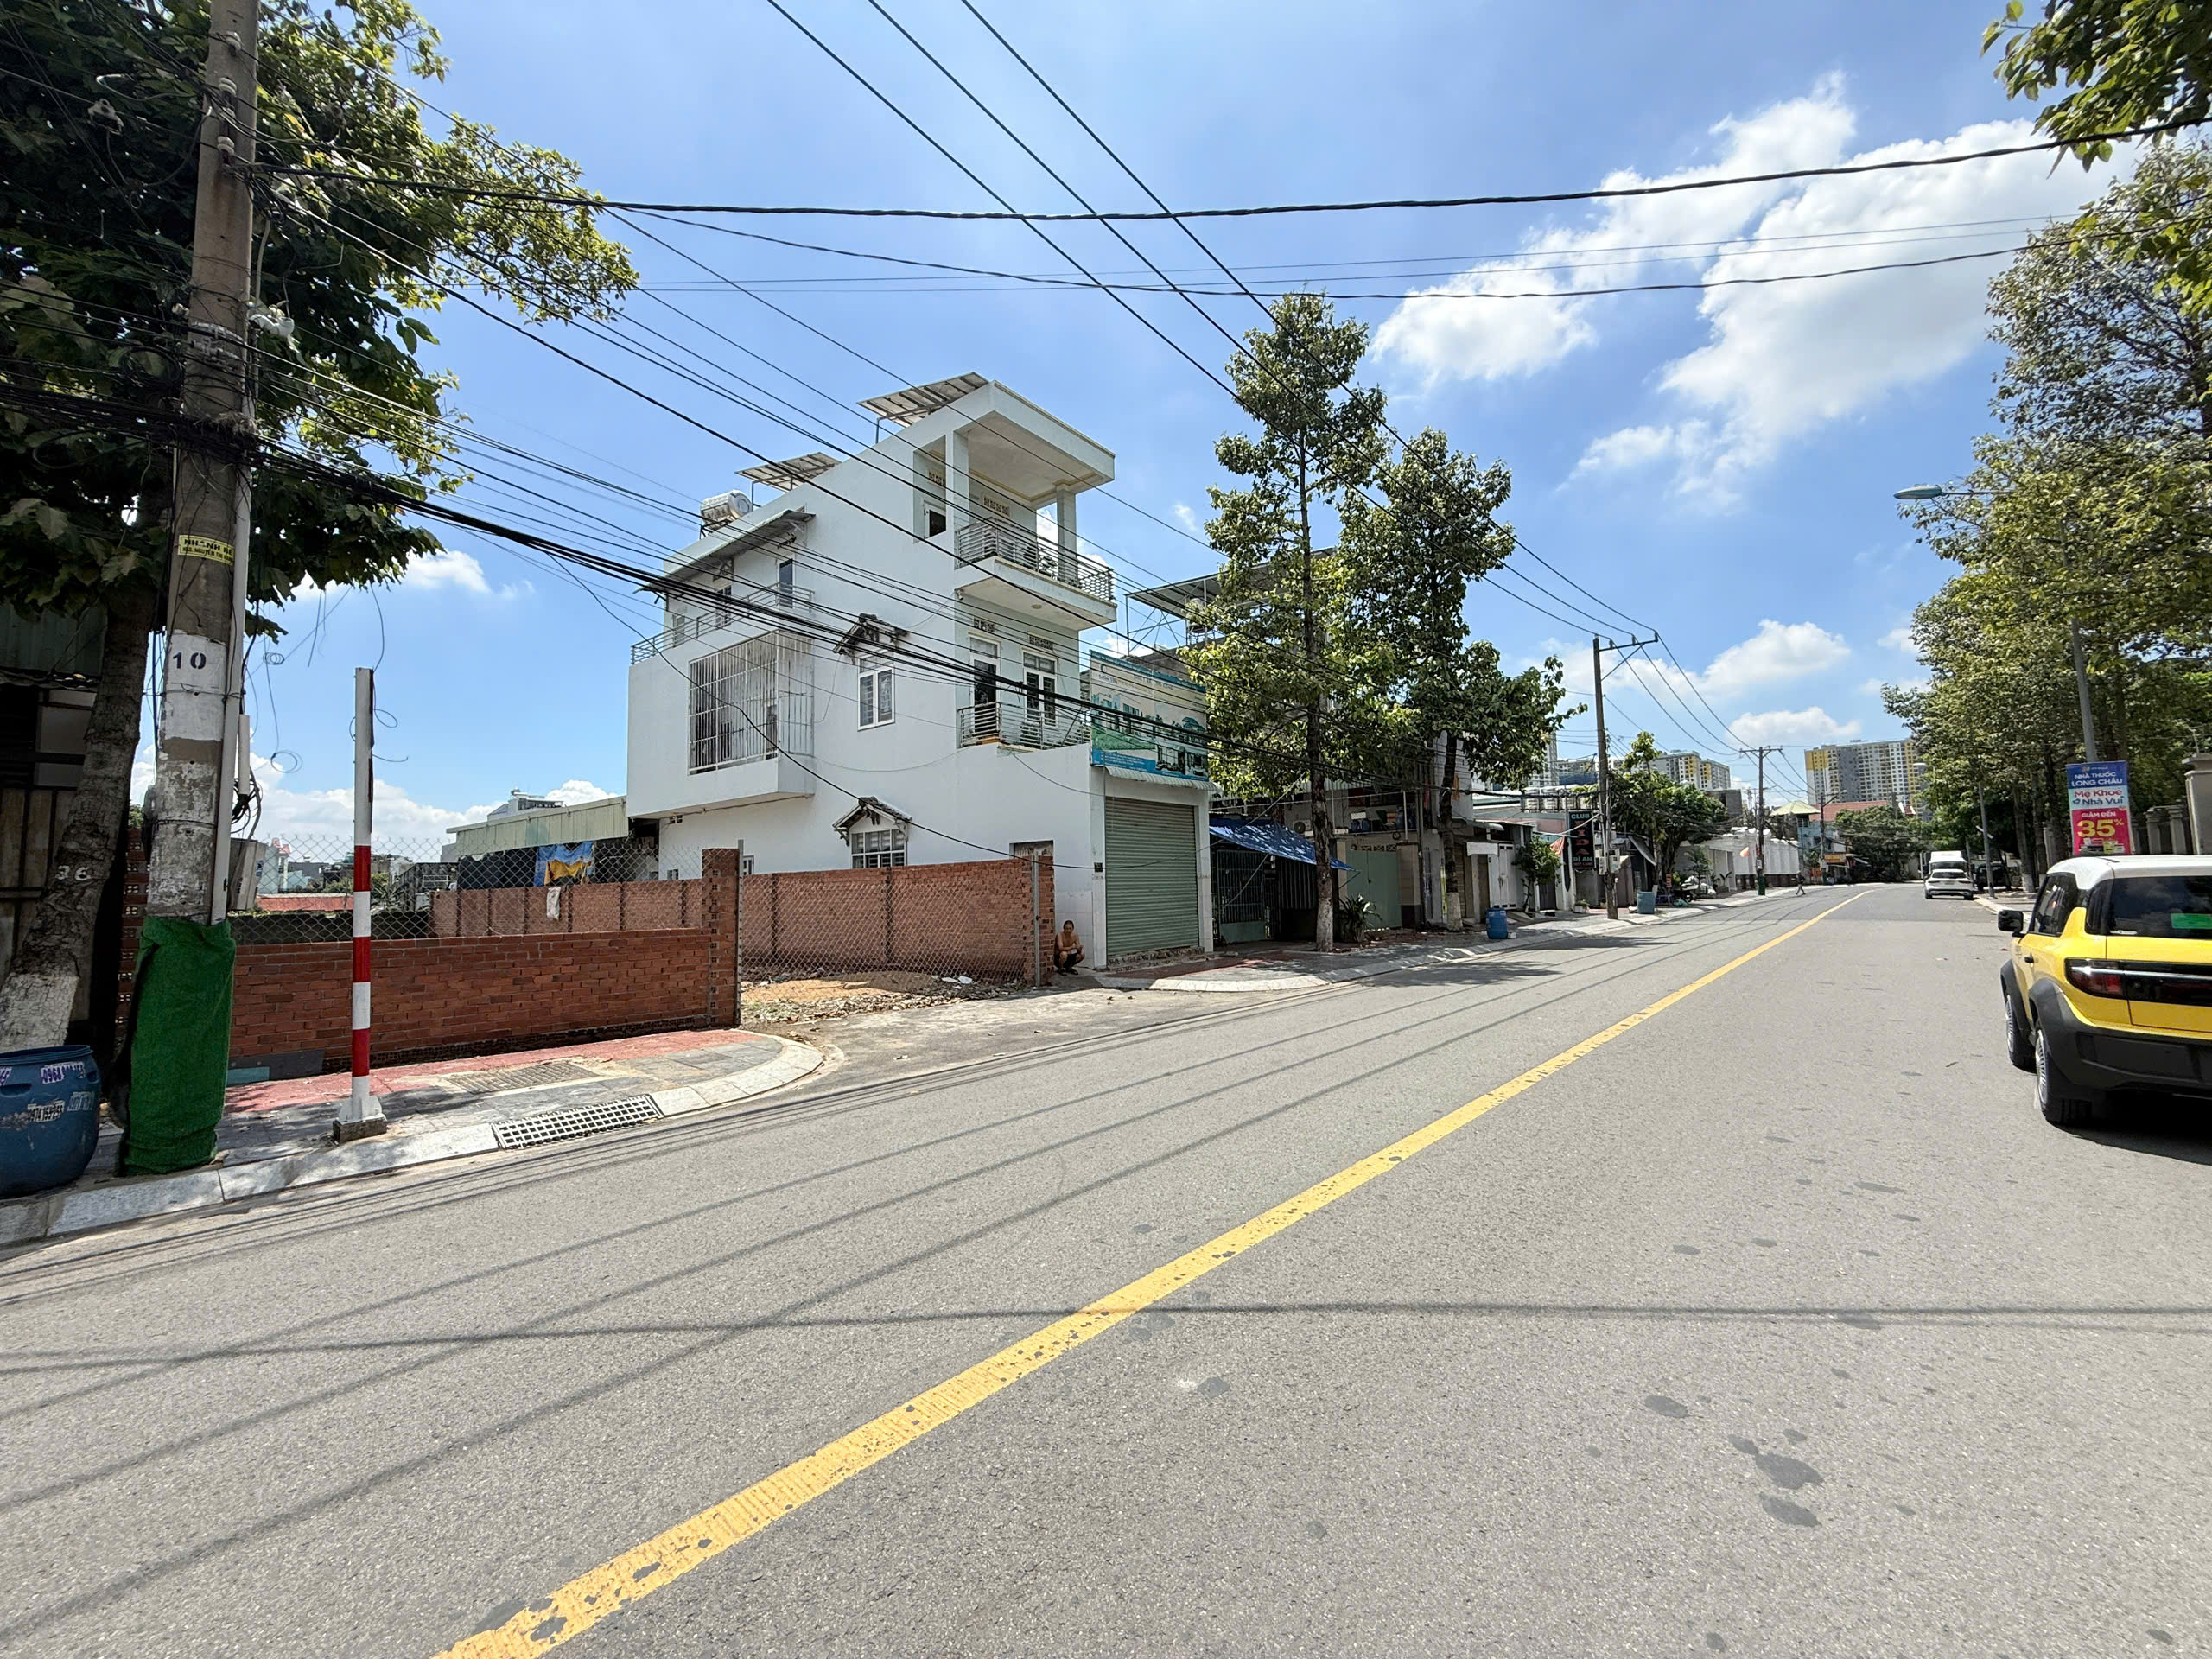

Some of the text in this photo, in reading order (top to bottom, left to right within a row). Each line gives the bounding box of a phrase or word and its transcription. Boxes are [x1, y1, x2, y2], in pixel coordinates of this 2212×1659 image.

[172, 652, 207, 670] 10
[2097, 777, 2123, 785] CHÂU
[2074, 790, 2091, 798] Mẹ
[2105, 796, 2124, 804] Vui
[2076, 818, 2125, 837] 35%
[55, 865, 92, 881] 36
